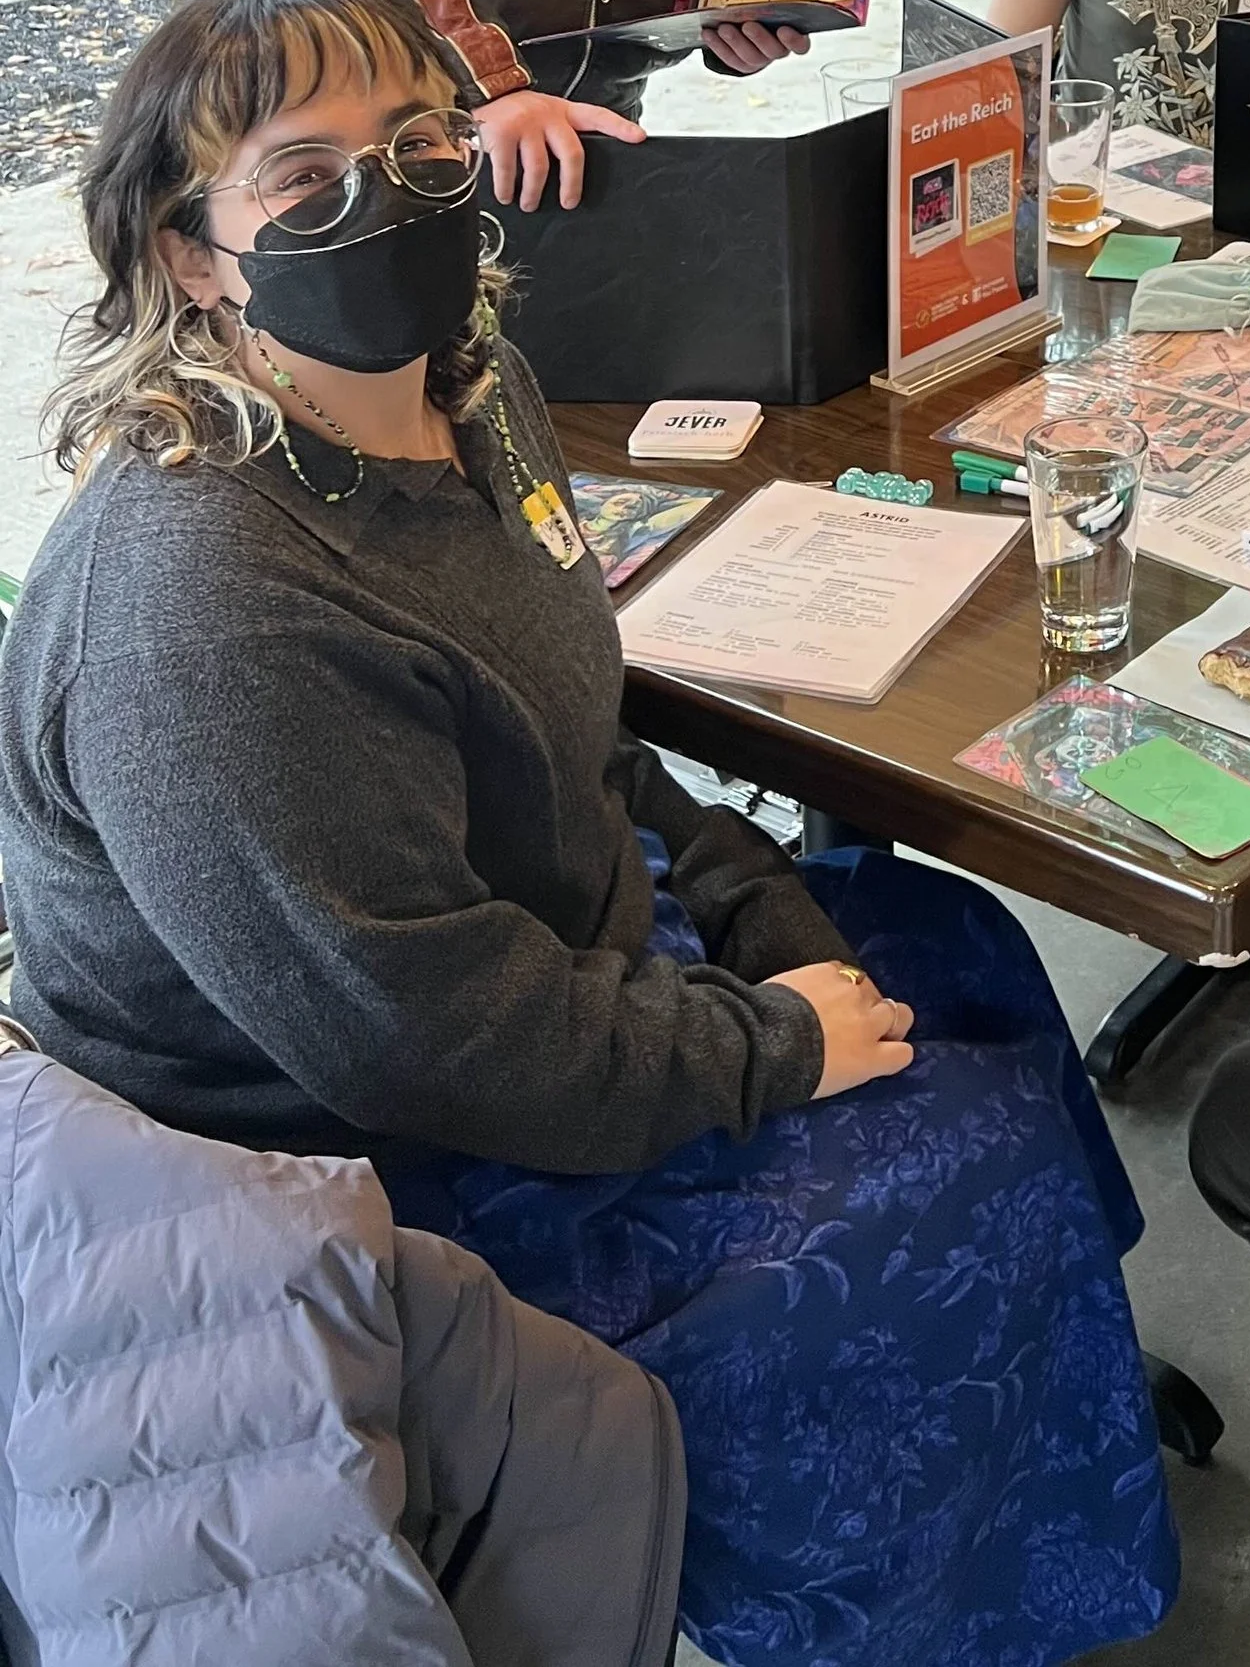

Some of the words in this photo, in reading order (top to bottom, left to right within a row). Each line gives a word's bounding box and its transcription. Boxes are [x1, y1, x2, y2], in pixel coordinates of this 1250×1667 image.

[911, 118, 939, 144] Eat
[941, 111, 968, 133] the
[971, 92, 1013, 123] Reich
[664, 415, 728, 429] JEVER
[859, 511, 910, 523] ASTRID
